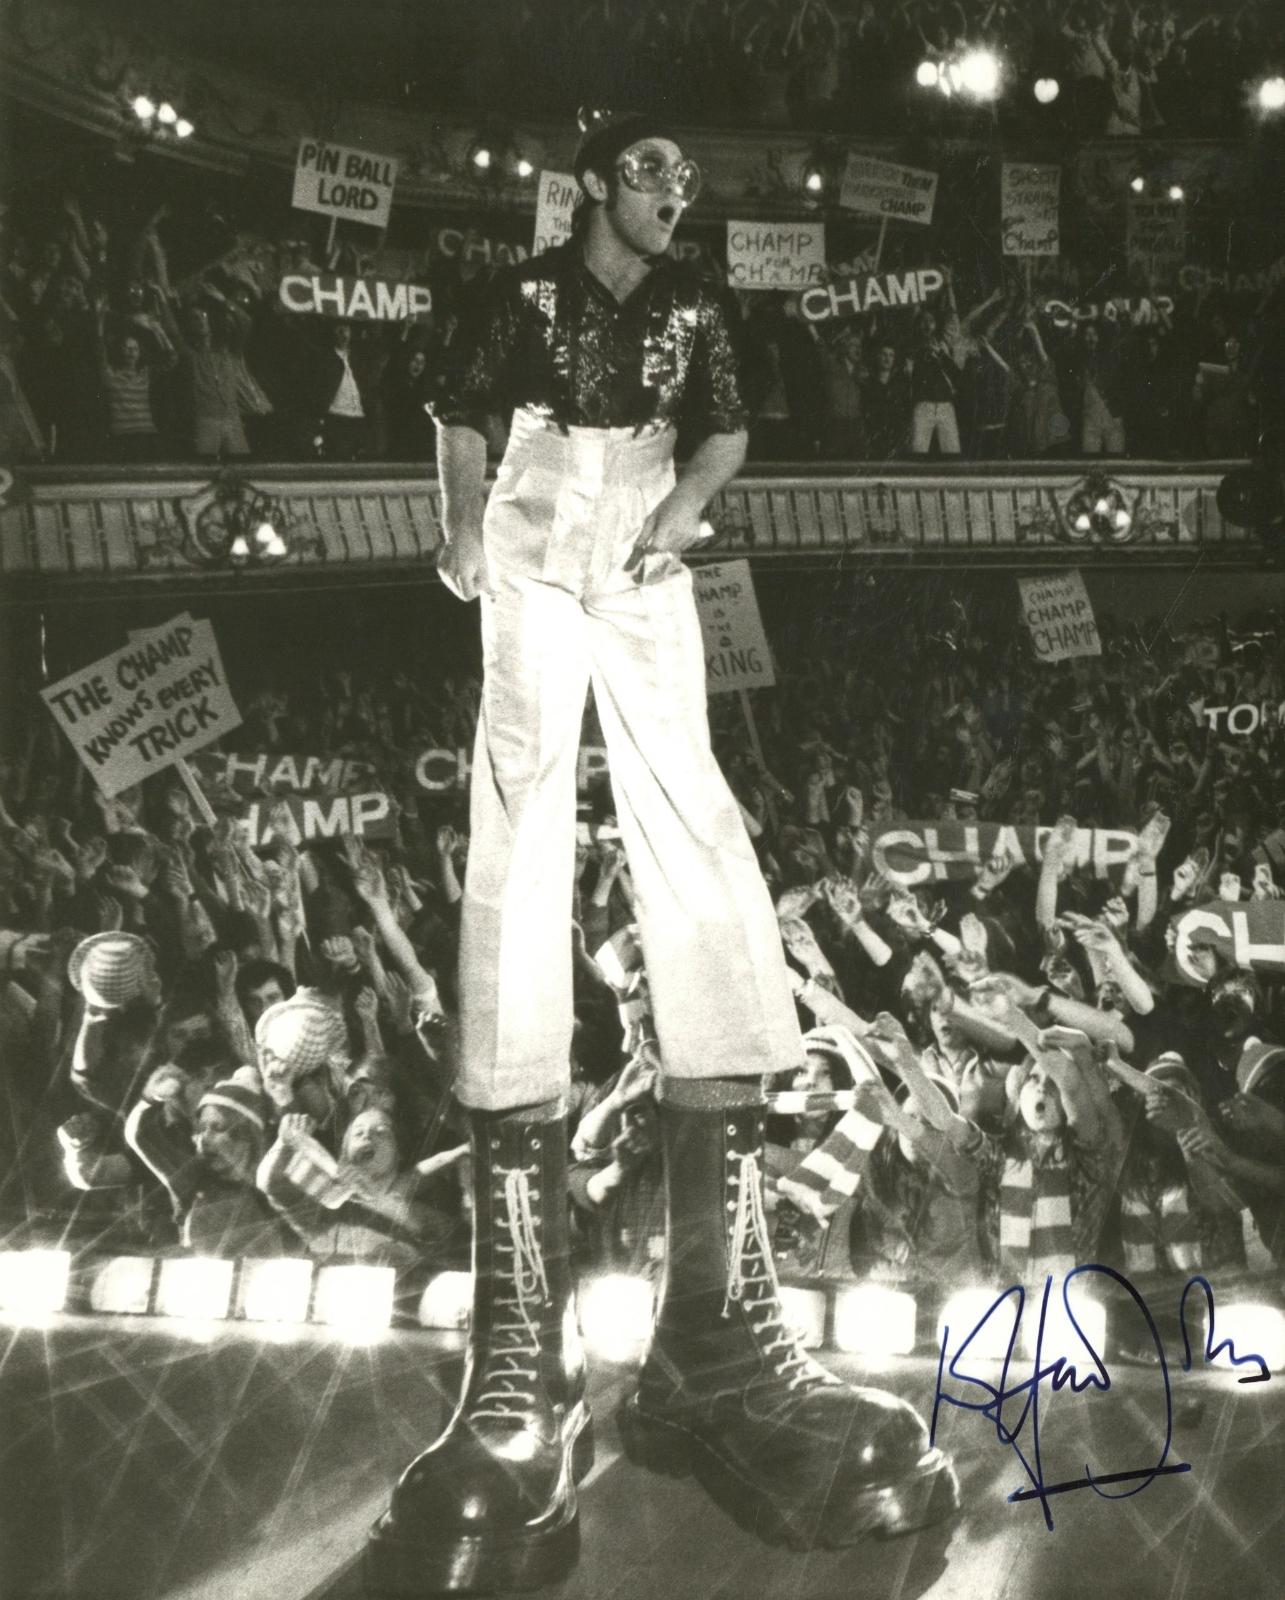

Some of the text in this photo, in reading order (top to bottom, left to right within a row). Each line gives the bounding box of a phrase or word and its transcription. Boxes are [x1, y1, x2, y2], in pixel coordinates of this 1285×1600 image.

[345, 154, 392, 187] BALL
[318, 179, 378, 211] LORD
[547, 181, 584, 208] RIN
[879, 199, 926, 216] CHAMP
[731, 231, 812, 255] CHAMP
[279, 275, 432, 320] CHAMP
[801, 269, 944, 321] CHAMP
[697, 582, 741, 603] HAMP
[1027, 599, 1086, 625] CHAMP
[1034, 618, 1097, 656] CHAMP
[50, 626, 193, 724] THE CHAMP
[706, 646, 763, 678] KING
[83, 657, 220, 767] KNOWS EVERY
[129, 696, 219, 763] TRICK
